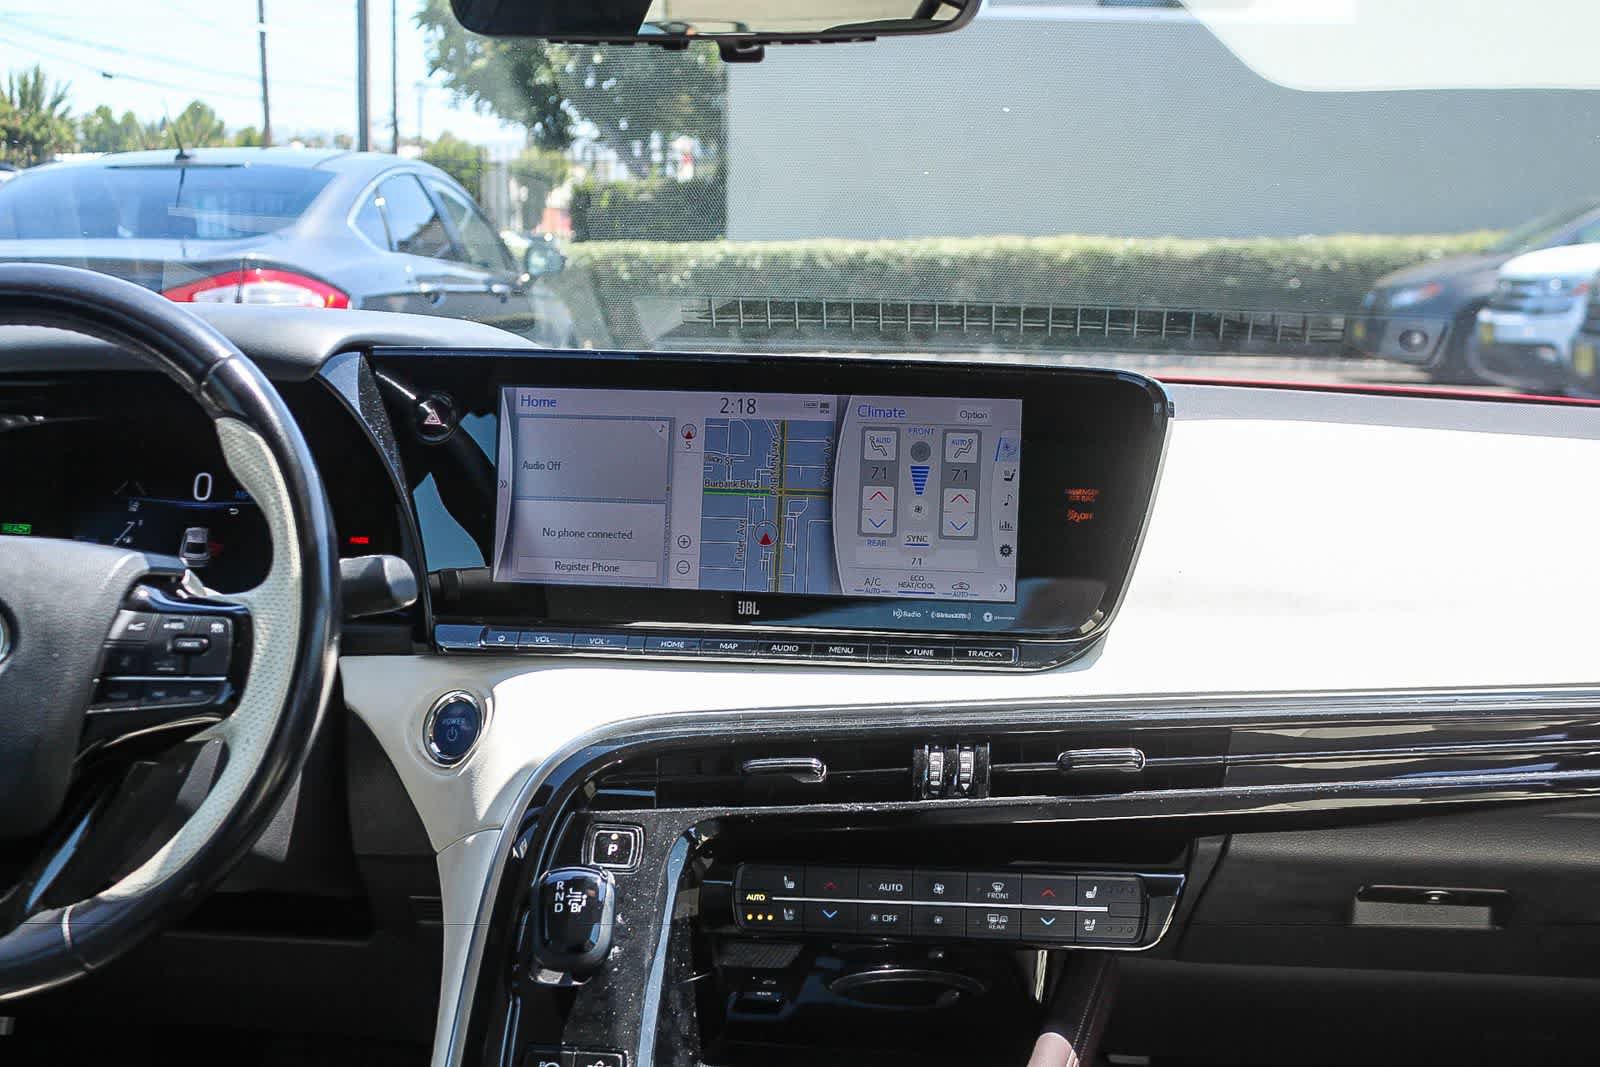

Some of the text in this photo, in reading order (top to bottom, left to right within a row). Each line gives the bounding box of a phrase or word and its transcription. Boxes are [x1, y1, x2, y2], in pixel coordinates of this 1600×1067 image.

[520, 395, 557, 408] Home
[720, 397, 756, 415] 2:18
[857, 404, 906, 418] Climate
[960, 410, 988, 421] Option
[908, 428, 935, 436] FRONT
[875, 436, 891, 444] AUTO
[522, 460, 561, 471] Audio Off
[871, 466, 888, 480] 71
[951, 469, 968, 482] 71
[193, 471, 212, 501] 0
[704, 479, 760, 490] Burbank Blvd
[542, 527, 633, 540] No phone connected
[866, 539, 887, 548] REAR
[906, 535, 929, 544] SYNC
[554, 560, 620, 573] Register Phone
[911, 557, 923, 566] 71
[864, 577, 882, 587] A/C
[898, 582, 936, 590] HEAT/COOL
[738, 600, 760, 615] JBL
[660, 641, 685, 649] HOME
[719, 642, 739, 650] MAP
[771, 644, 799, 652] AUDIO
[829, 646, 854, 654] MENU
[913, 649, 934, 657] TUNE
[967, 650, 995, 658] TRACK
[607, 843, 618, 856] P
[556, 881, 564, 890] R
[879, 883, 903, 893] AUTO
[555, 892, 564, 902] N
[746, 893, 766, 901] AUTO
[987, 892, 1009, 900] FRONT
[554, 902, 564, 913] D
[882, 914, 898, 922] OFF
